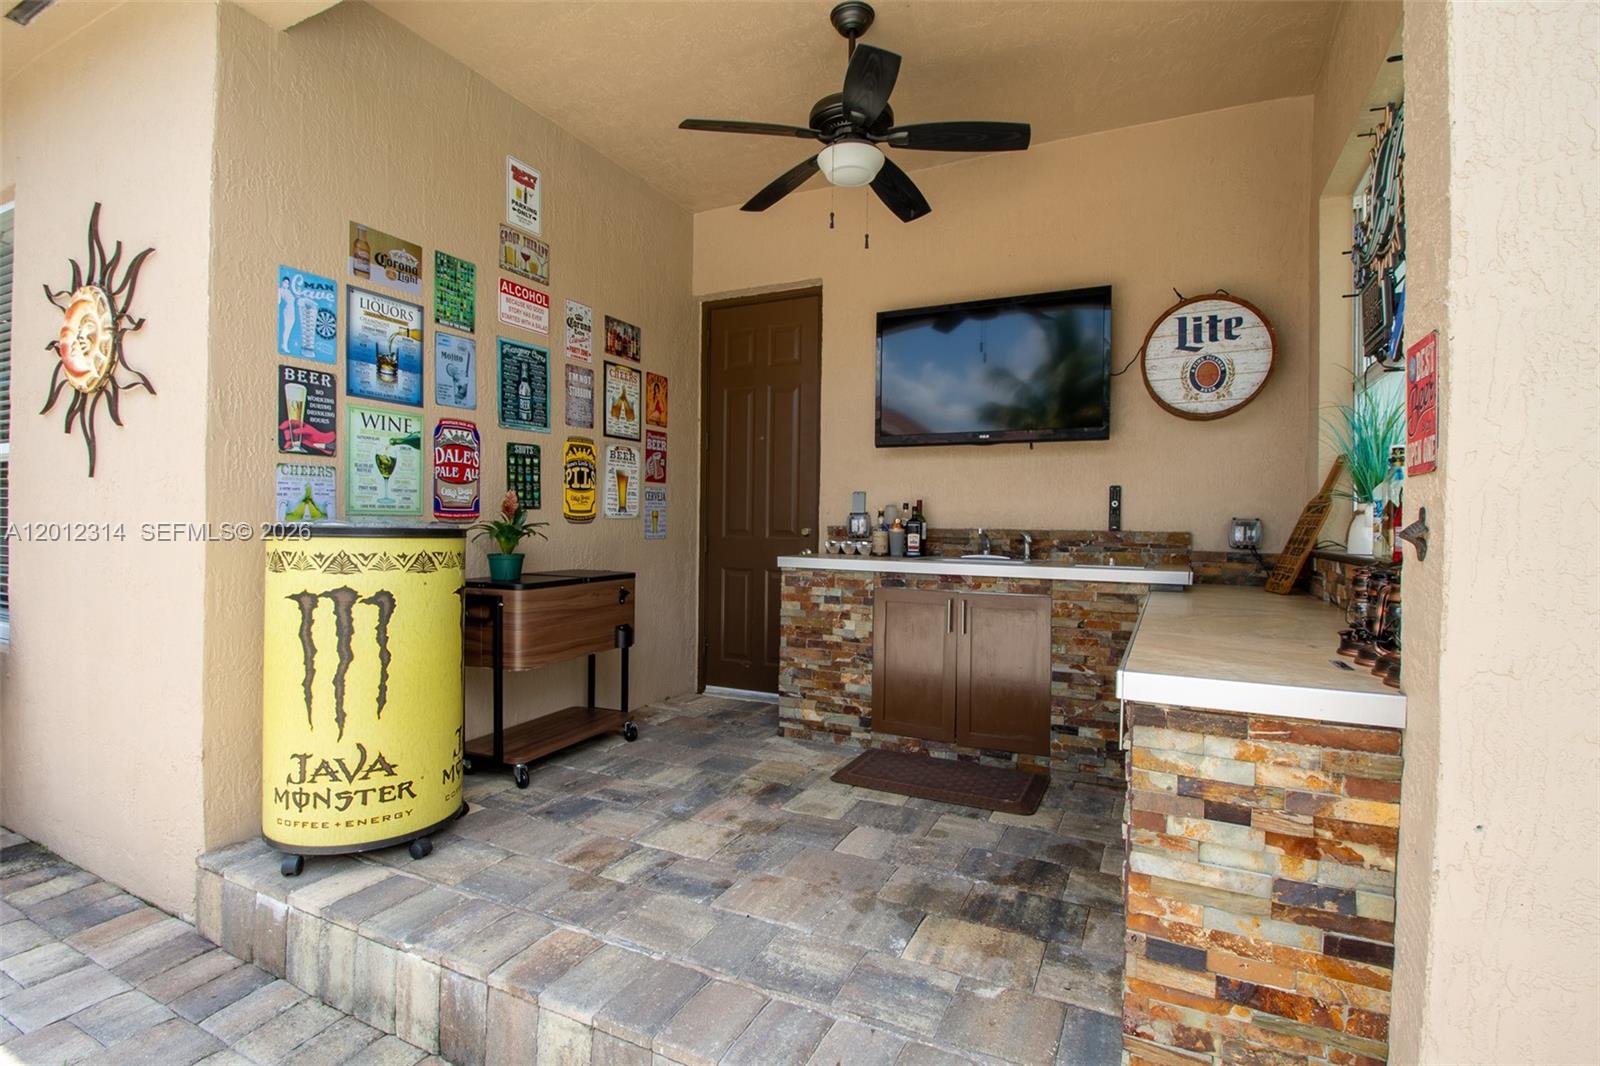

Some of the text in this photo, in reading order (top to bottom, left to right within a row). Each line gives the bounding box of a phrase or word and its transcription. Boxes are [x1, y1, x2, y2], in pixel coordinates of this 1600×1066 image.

[374, 251, 418, 275] Corona
[303, 281, 334, 292] MAN
[501, 280, 548, 307] ALCOHOL
[360, 297, 414, 322] LIQUORS
[1174, 314, 1244, 352] Lite
[284, 368, 332, 387] BEER
[609, 368, 638, 384] CHEERS
[360, 412, 413, 434] WINE
[647, 438, 667, 452] BEER
[435, 446, 480, 468] DALE'S
[609, 450, 636, 462] BEER
[280, 464, 334, 478] CHEERS
[435, 466, 459, 480] PALE
[286, 743, 399, 786] JAVA
[274, 780, 418, 813] MONSTER
[276, 817, 330, 829] COFFEE
